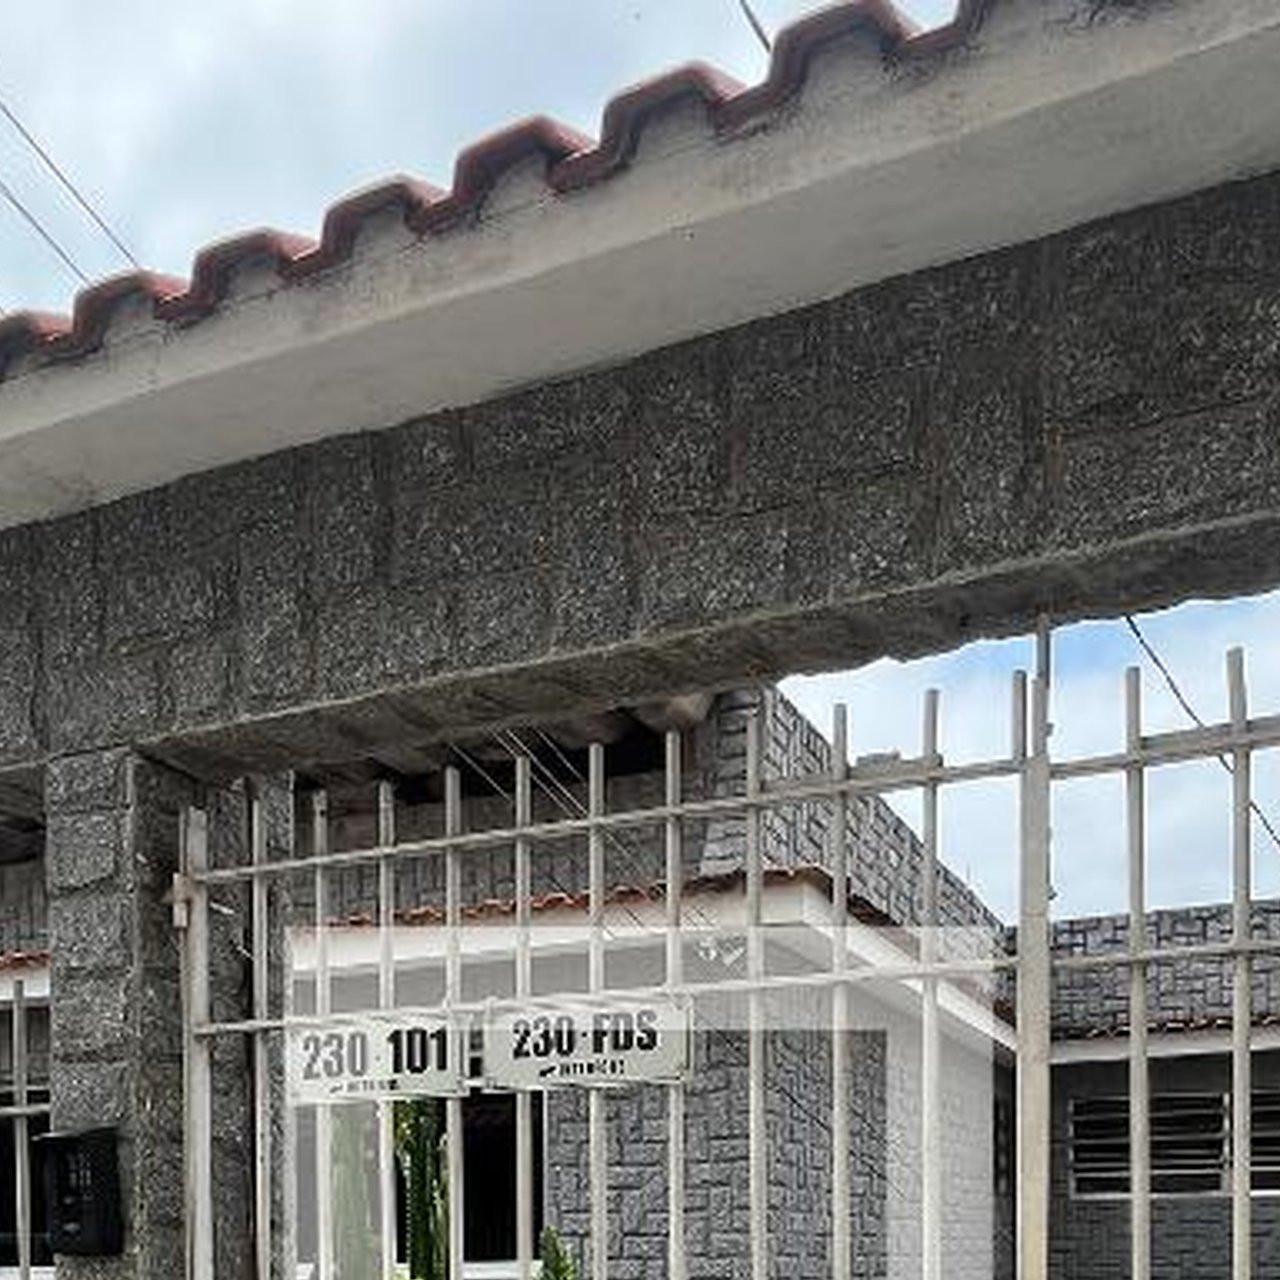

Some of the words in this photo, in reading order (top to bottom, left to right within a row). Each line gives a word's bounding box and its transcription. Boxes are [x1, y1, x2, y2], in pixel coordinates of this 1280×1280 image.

[303, 1032, 368, 1079] 230
[387, 1026, 448, 1074] 101
[513, 1016, 574, 1058] 230
[593, 1010, 657, 1053] FDS
